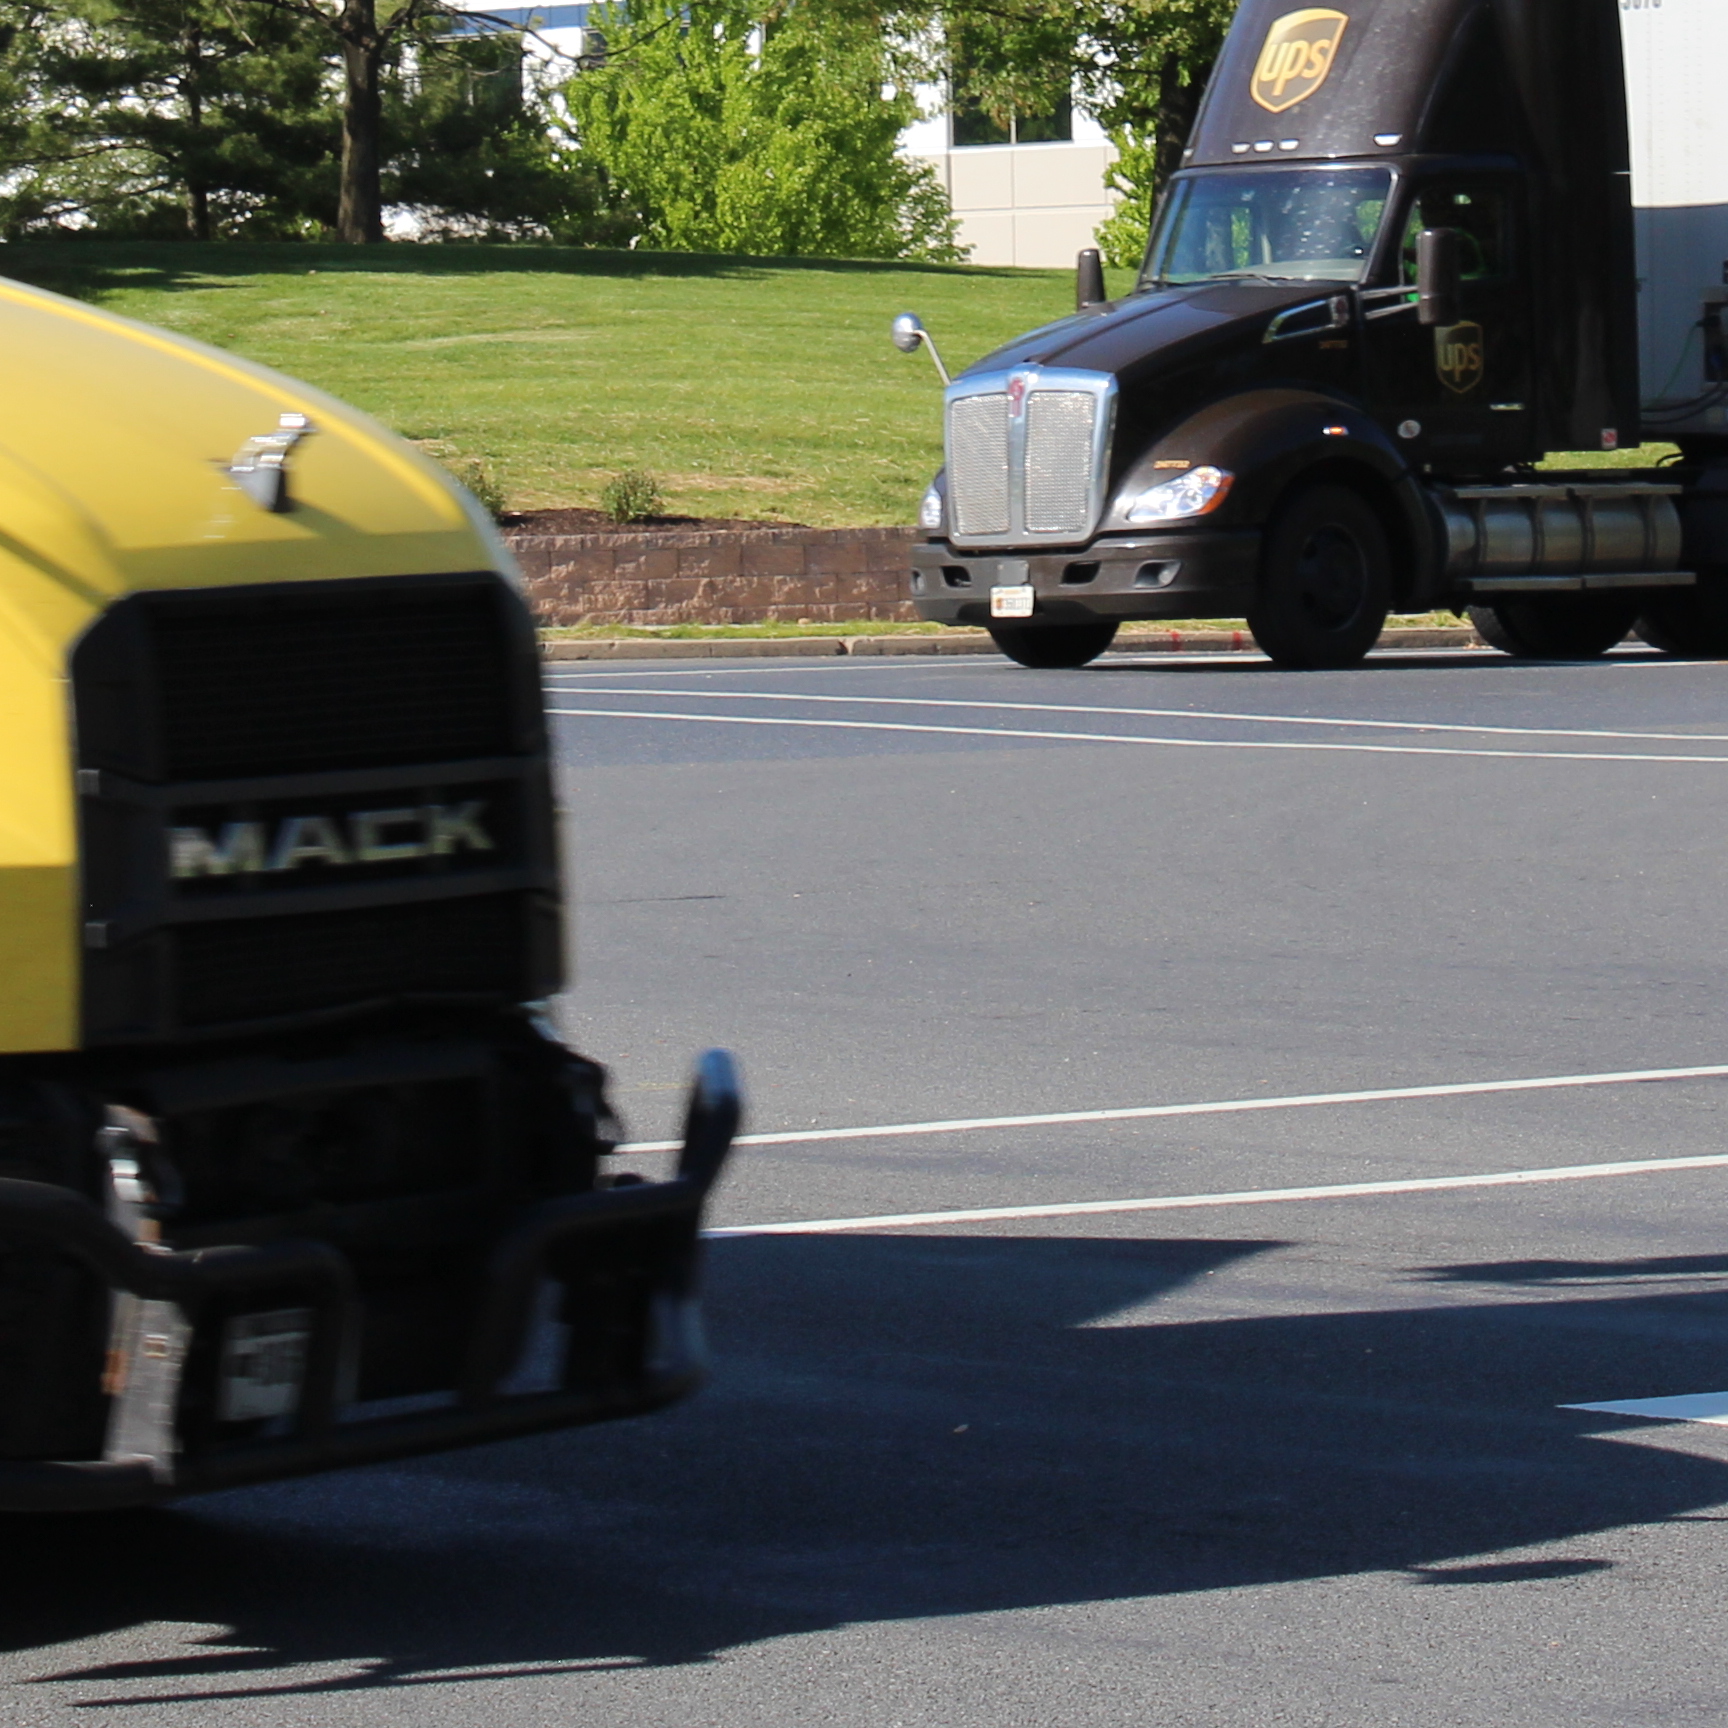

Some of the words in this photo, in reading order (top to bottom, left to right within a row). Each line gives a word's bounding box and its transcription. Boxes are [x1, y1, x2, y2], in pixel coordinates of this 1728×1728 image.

[1259, 39, 1333, 96] ups
[1438, 343, 1482, 382] ups
[169, 802, 494, 878] MACK
